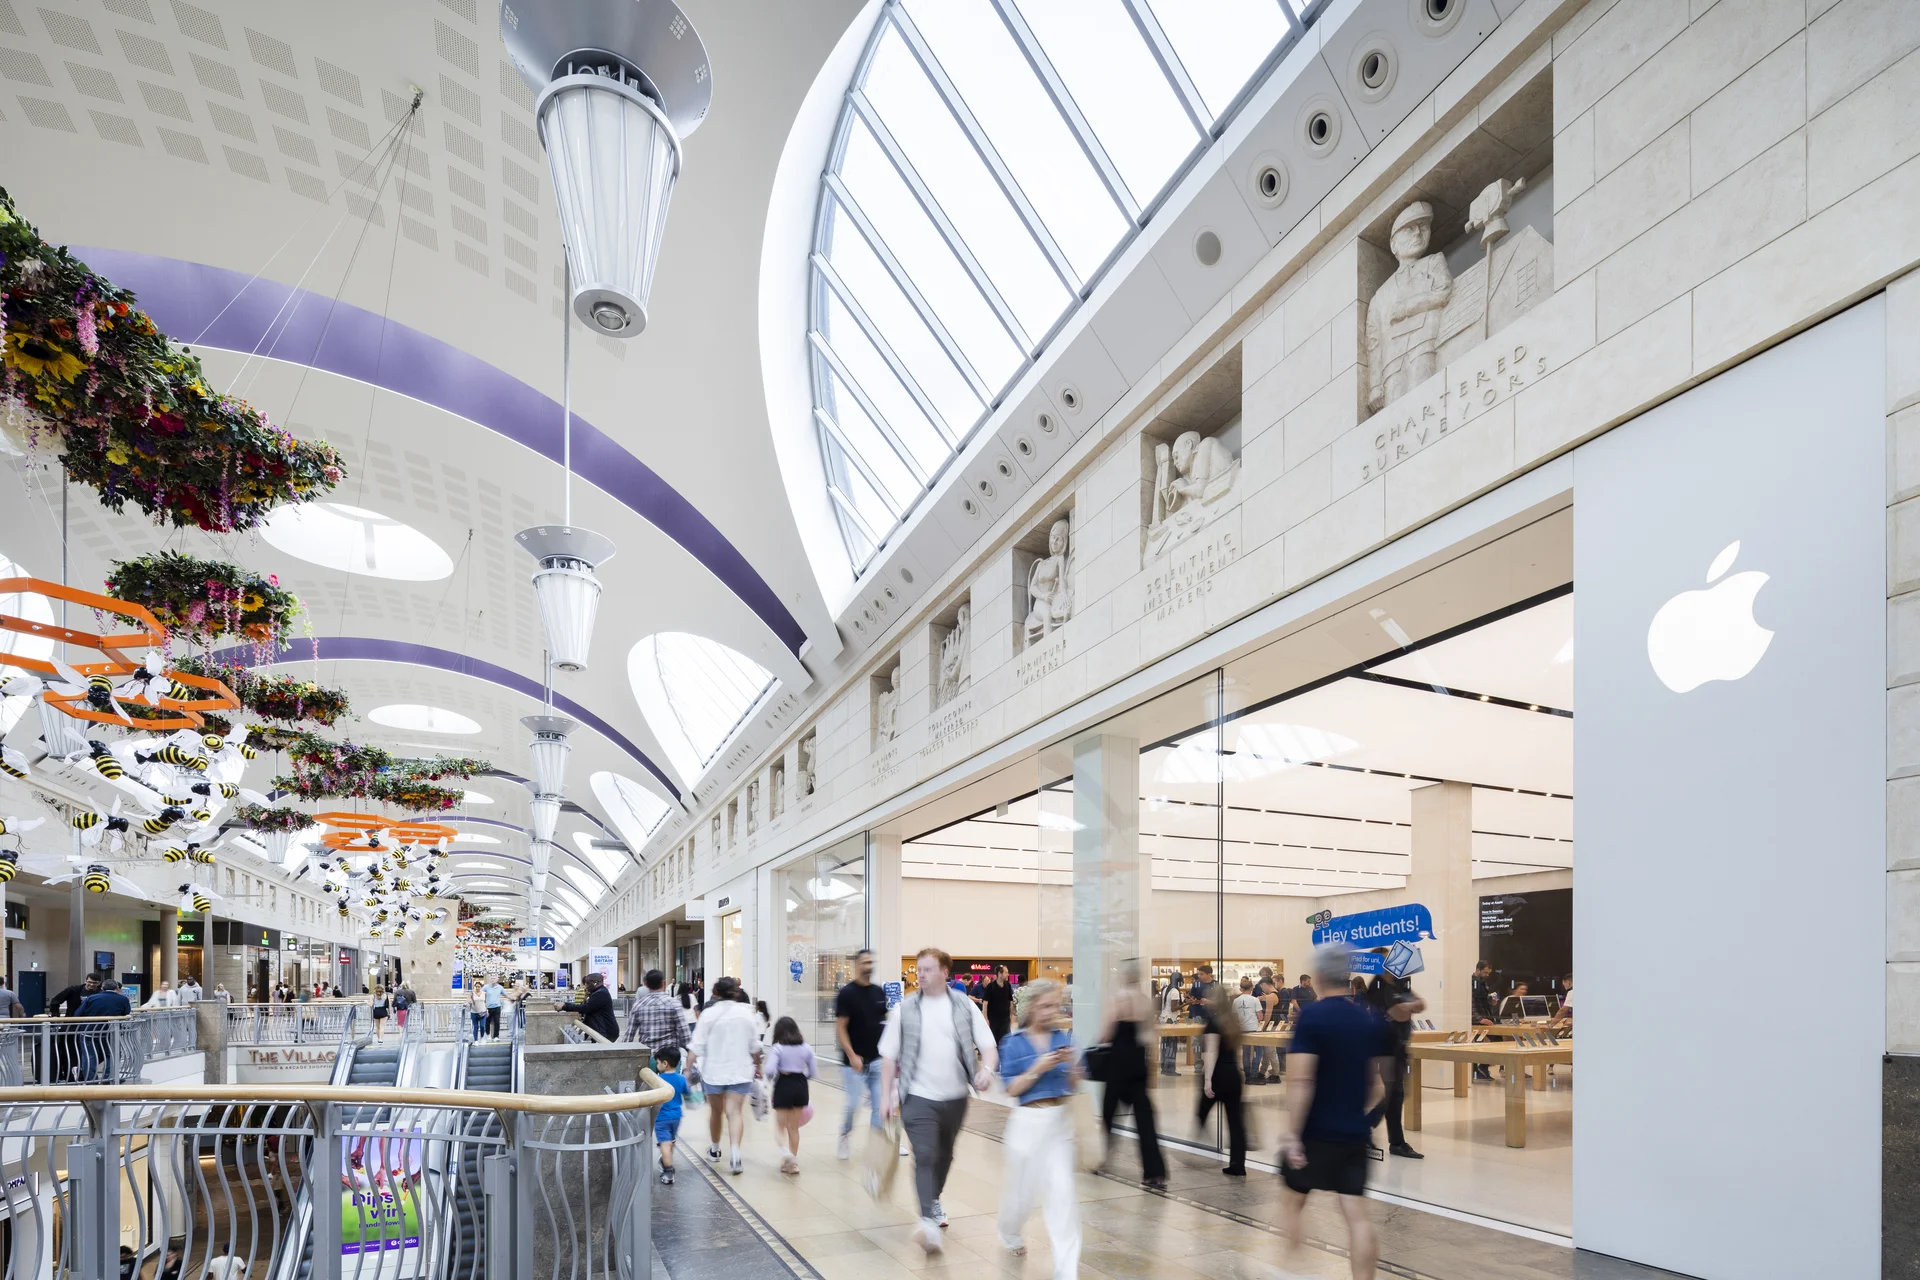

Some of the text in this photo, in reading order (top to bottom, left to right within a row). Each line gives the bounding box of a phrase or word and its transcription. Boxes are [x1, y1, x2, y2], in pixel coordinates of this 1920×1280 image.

[1362, 356, 1548, 480] SURVEYORS
[1374, 345, 1528, 450] CHARTERED
[1144, 547, 1236, 613] INSTRUMENT
[1146, 533, 1232, 595] SCIENTIFIC
[1322, 915, 1419, 944] Hey students!
[248, 1049, 336, 1063] THE VILLAG
[352, 1192, 393, 1208] Dips
